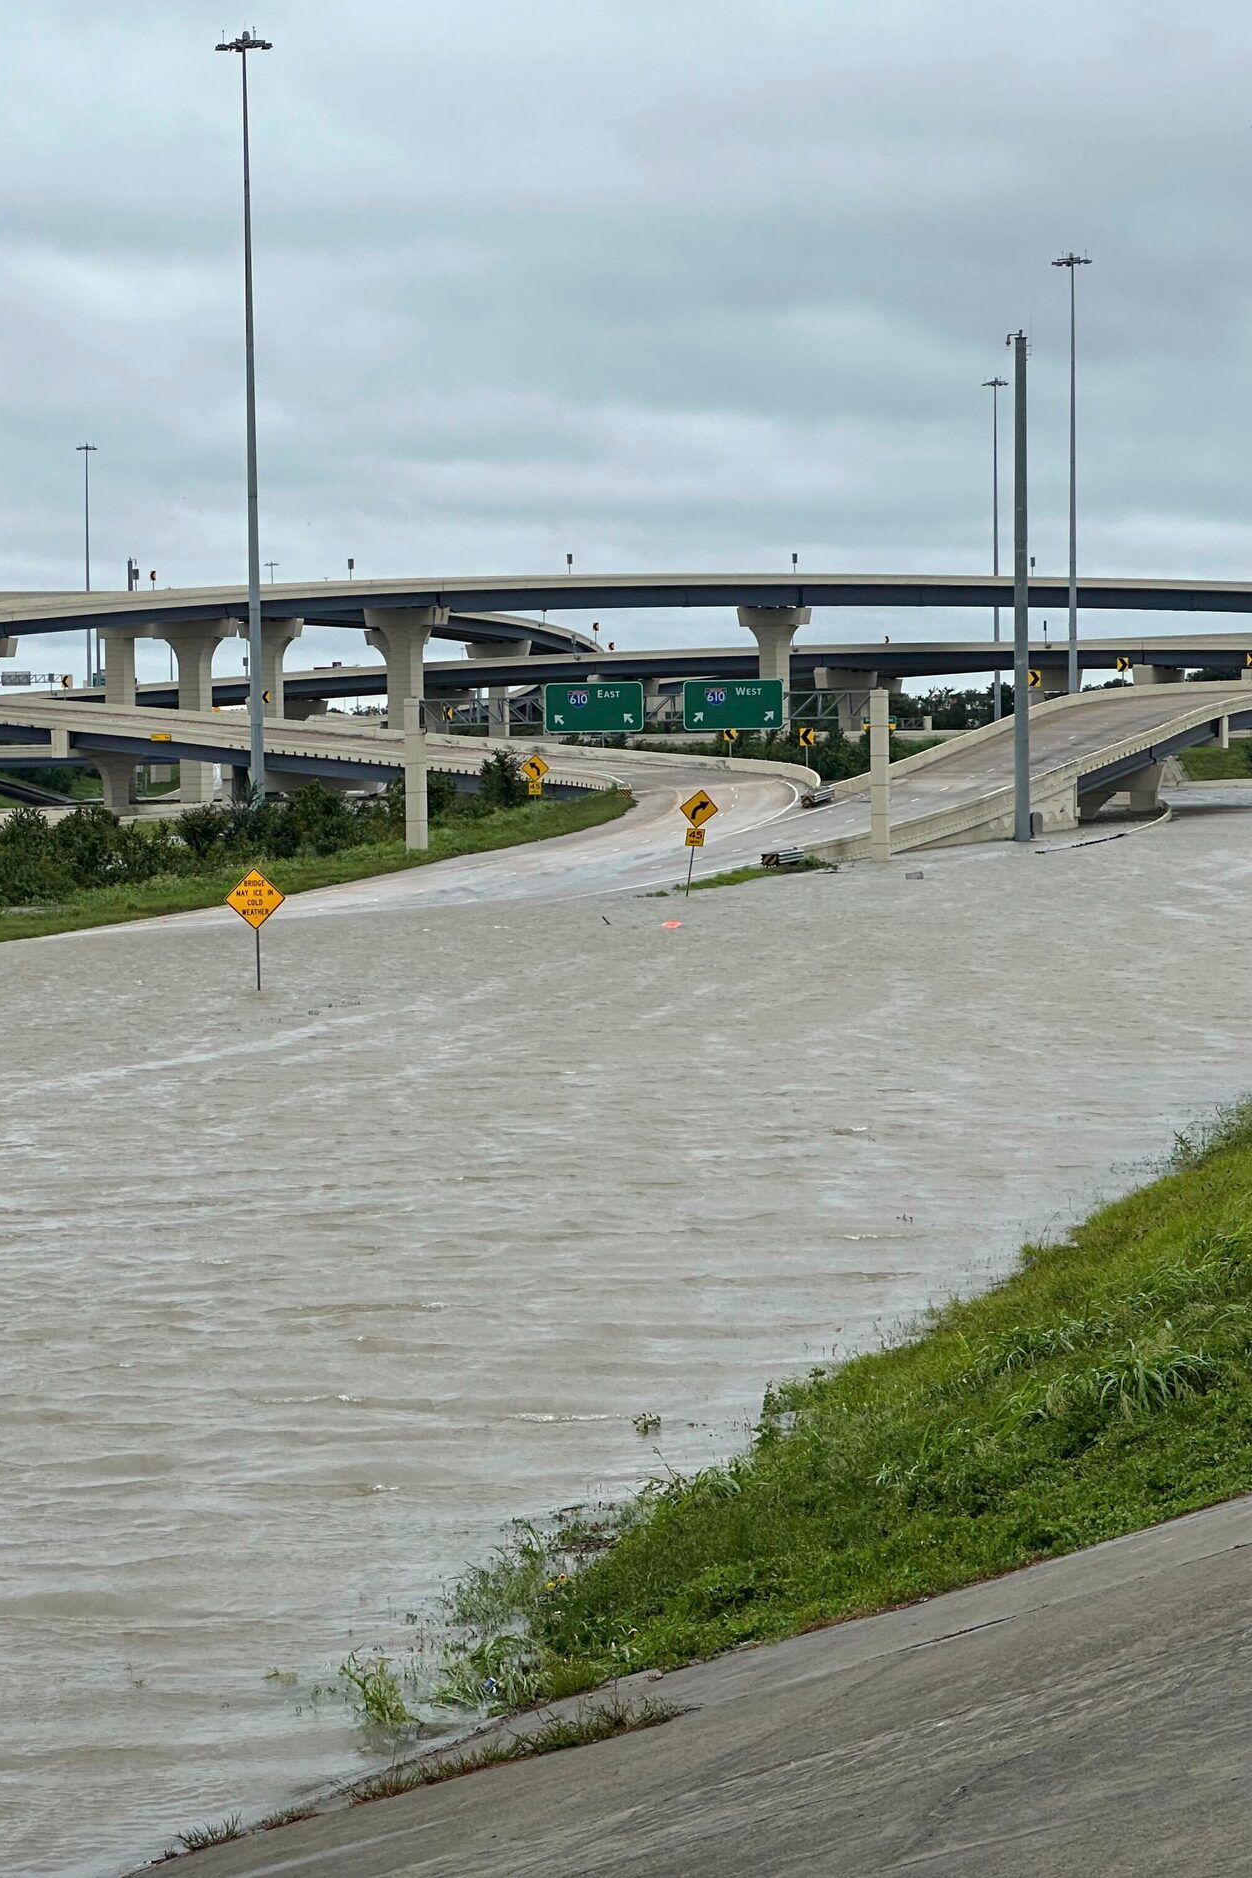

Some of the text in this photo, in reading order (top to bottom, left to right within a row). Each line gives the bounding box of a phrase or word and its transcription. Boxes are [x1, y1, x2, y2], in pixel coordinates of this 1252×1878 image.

[569, 689, 620, 704] 610 EAST
[707, 687, 762, 702] 610 WEST
[688, 831, 703, 840] 45
